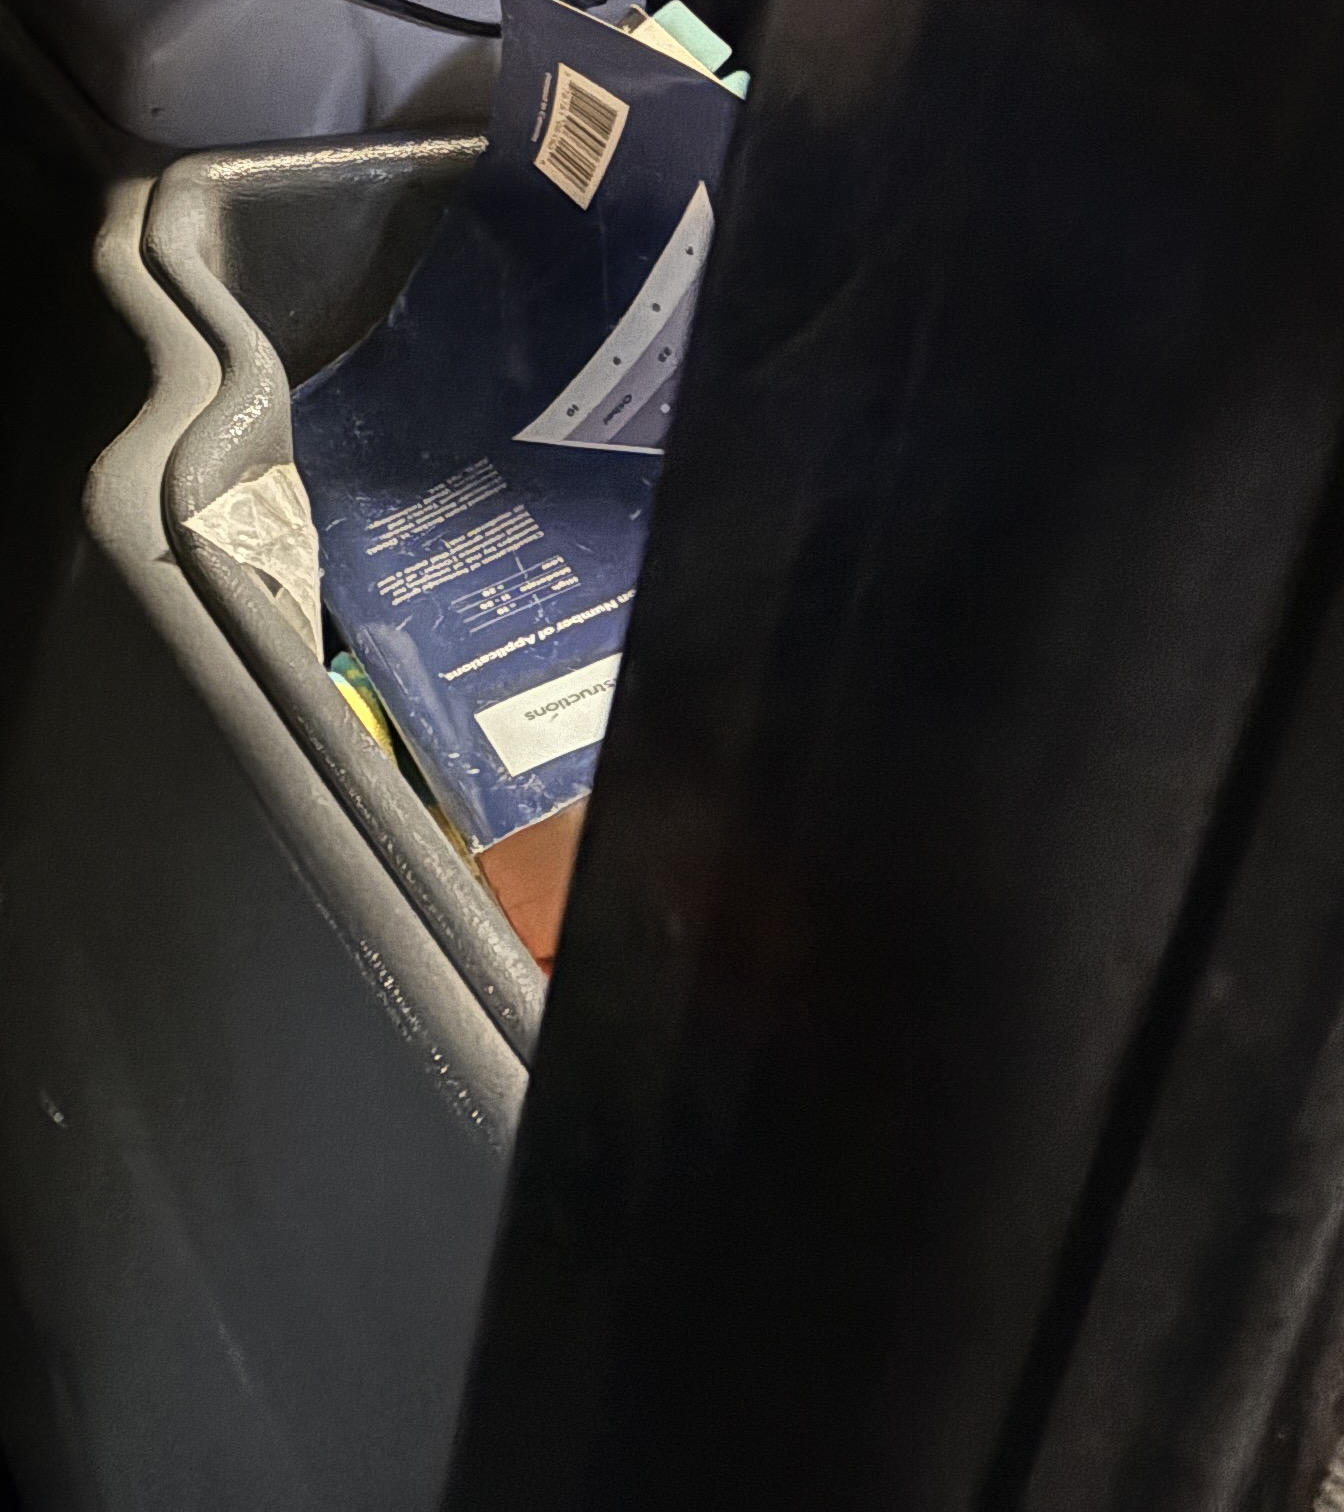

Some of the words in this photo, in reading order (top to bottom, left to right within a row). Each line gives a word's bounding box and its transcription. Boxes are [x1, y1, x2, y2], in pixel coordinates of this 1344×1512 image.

[537, 625, 555, 641] of
[556, 598, 619, 633] Number
[524, 677, 618, 722] structions
